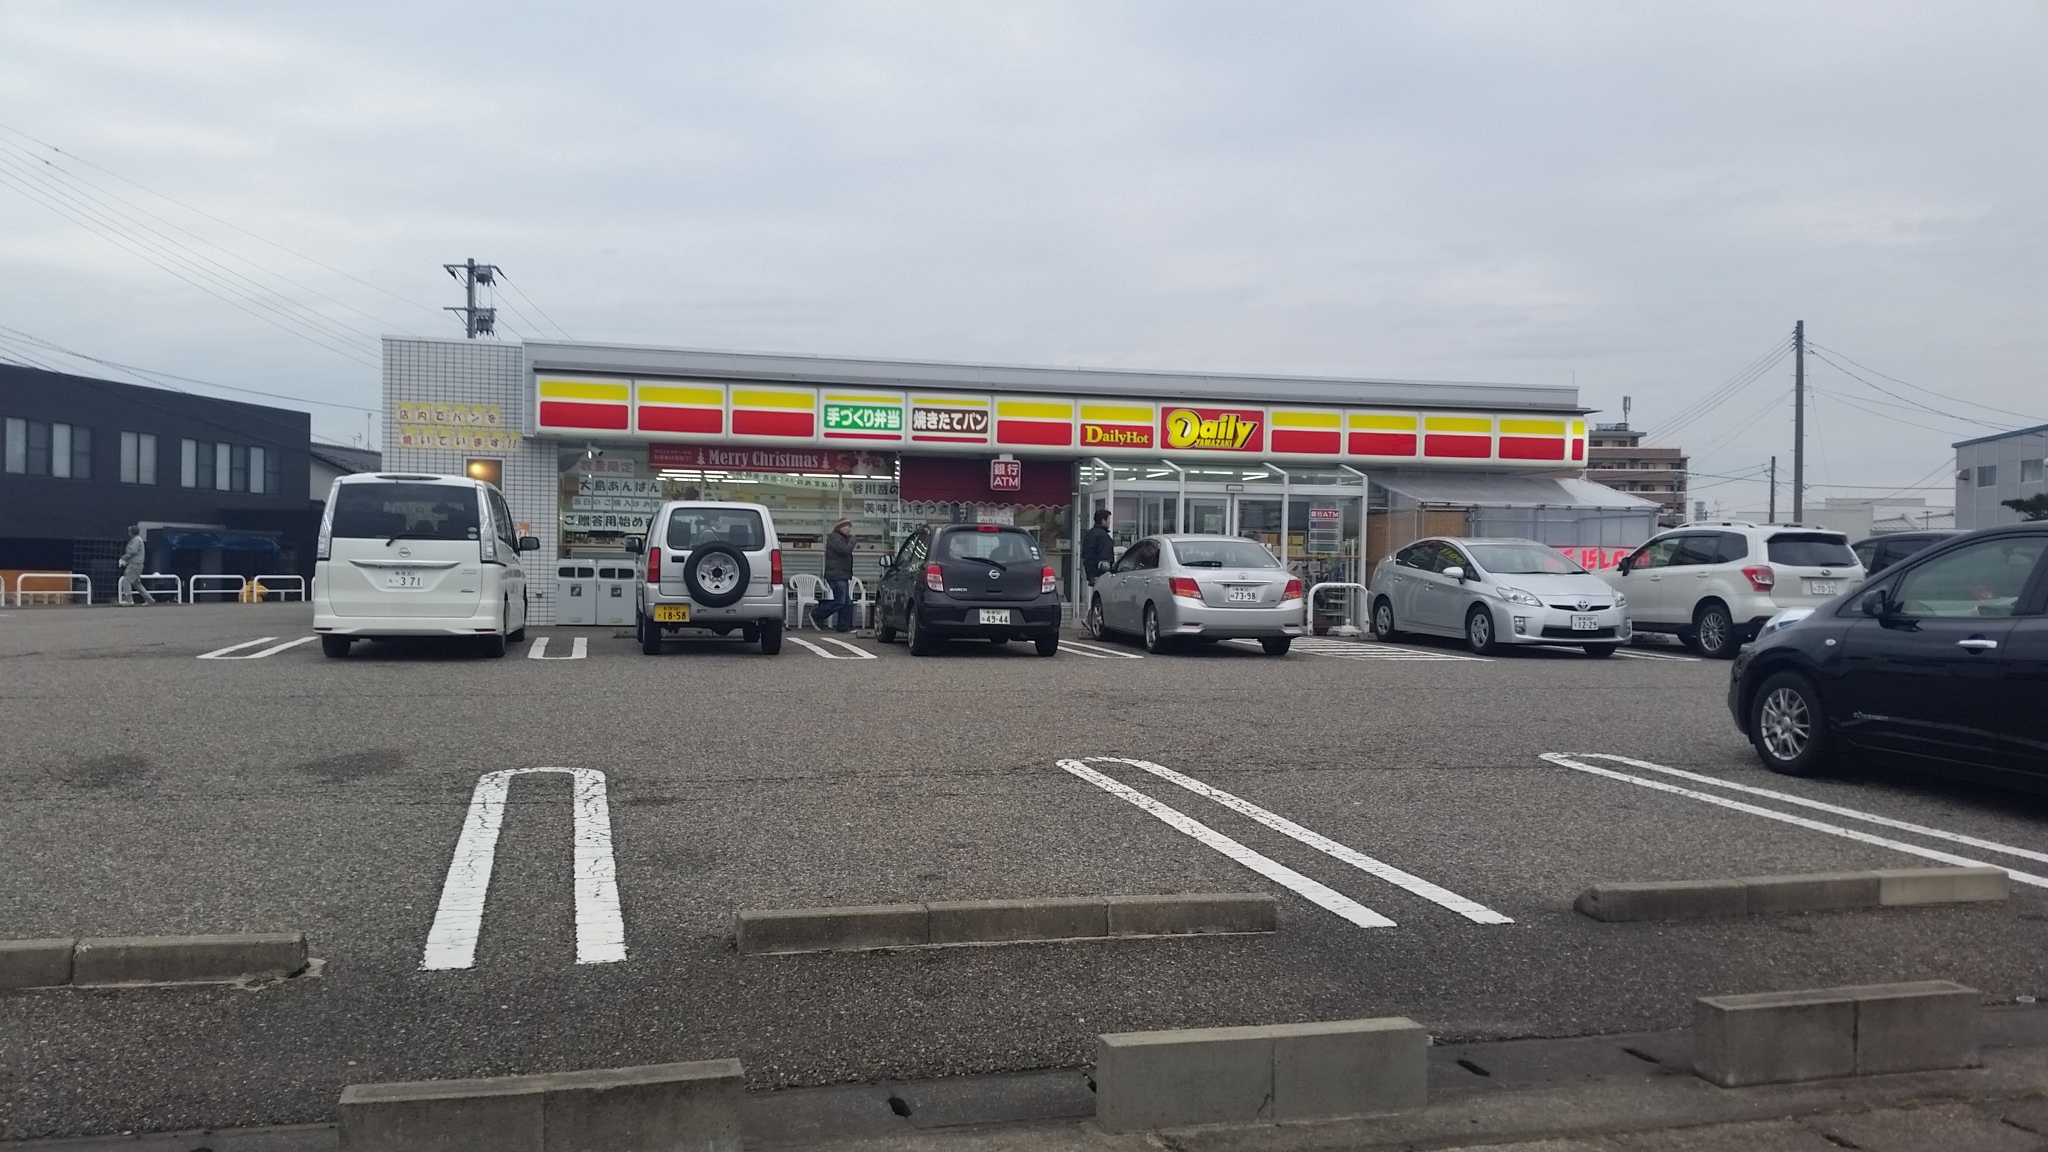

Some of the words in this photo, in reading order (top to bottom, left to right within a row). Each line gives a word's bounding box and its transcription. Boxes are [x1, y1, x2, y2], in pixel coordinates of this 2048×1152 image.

[826, 407, 901, 428] 手づくり弁当
[913, 410, 988, 431] 焼きたてパン
[1085, 425, 1150, 445] DailyHot
[1167, 409, 1259, 449] Daily
[1195, 438, 1234, 448] YAMAZAKI
[581, 461, 633, 473] 数量限定
[708, 449, 750, 468] Merry
[752, 451, 818, 469] Christmas
[994, 463, 1019, 476] 銀行
[993, 476, 1019, 487] ATM
